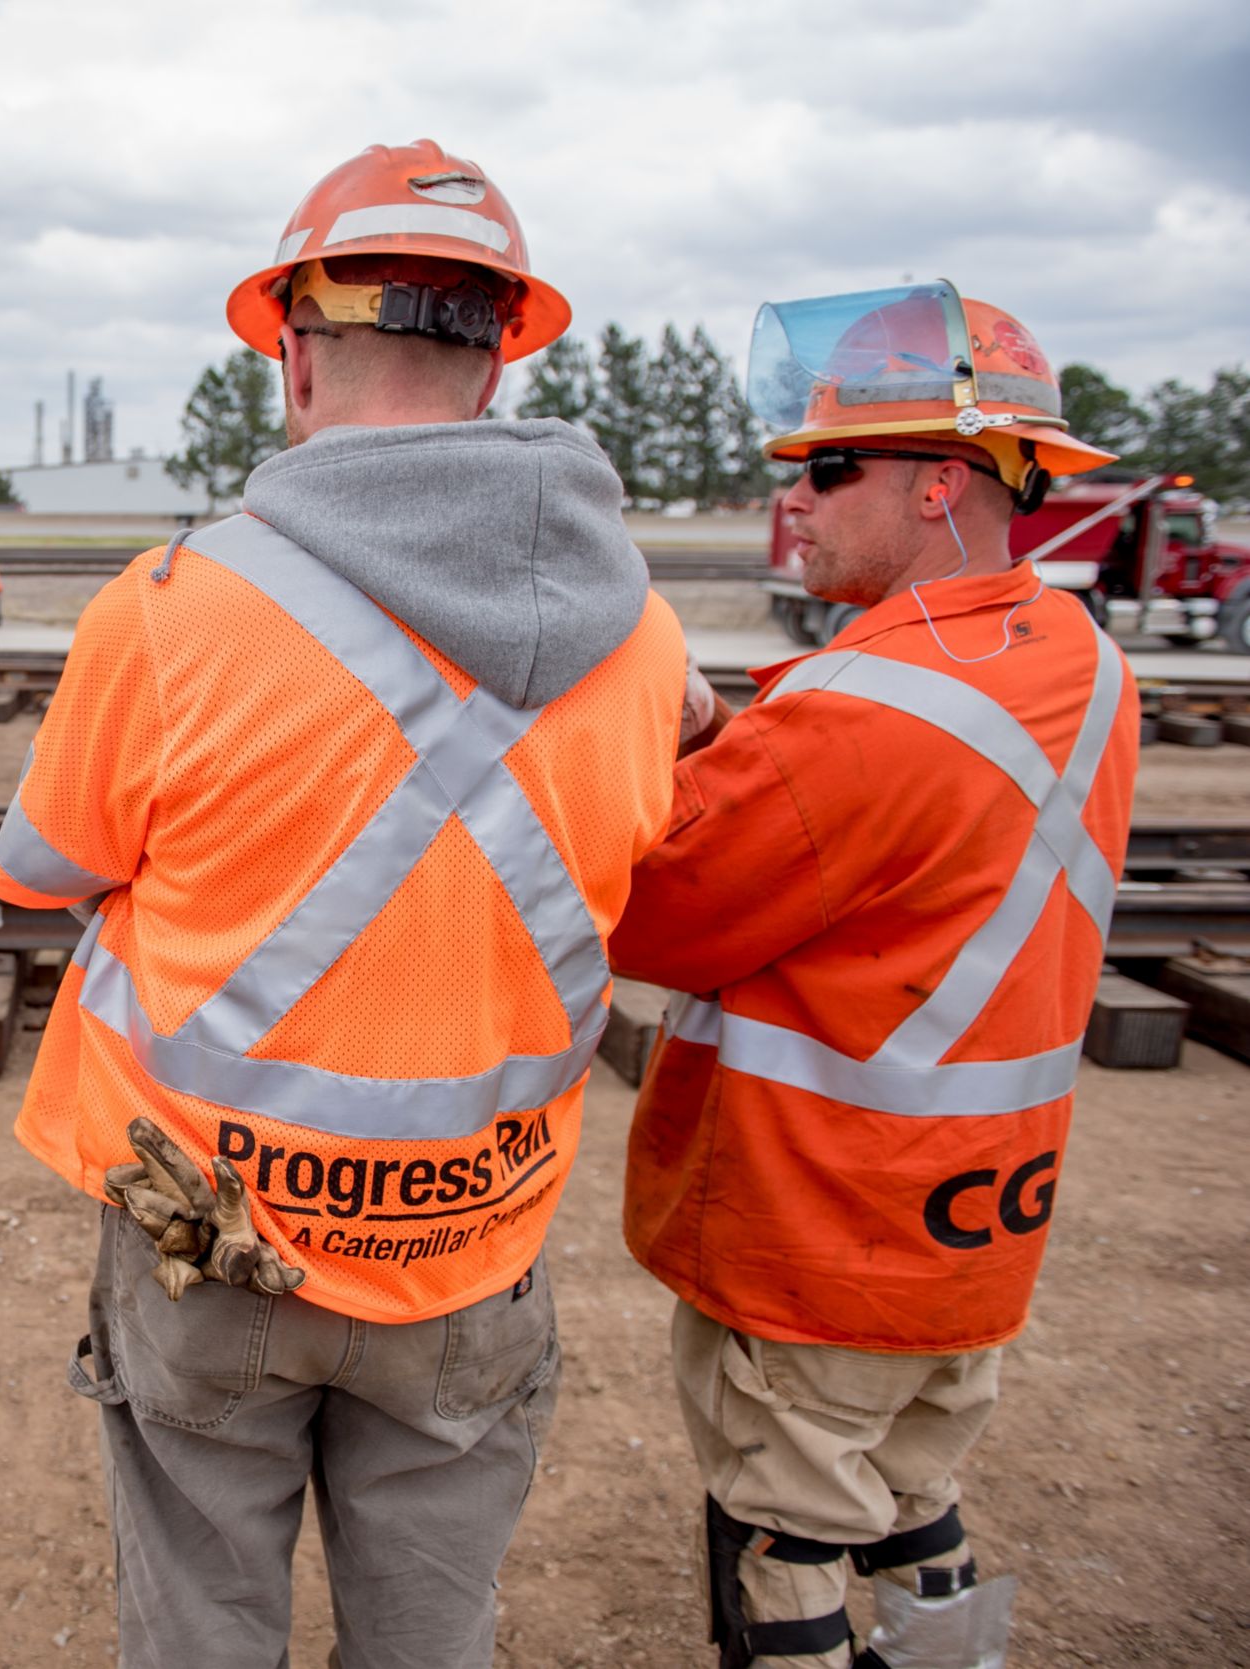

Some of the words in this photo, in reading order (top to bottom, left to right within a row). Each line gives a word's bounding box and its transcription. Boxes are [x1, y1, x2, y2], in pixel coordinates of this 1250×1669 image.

[218, 1120, 492, 1218] Progress
[496, 1112, 551, 1181] Rail
[291, 1228, 311, 1248] A
[322, 1225, 477, 1268] Caterpillar
